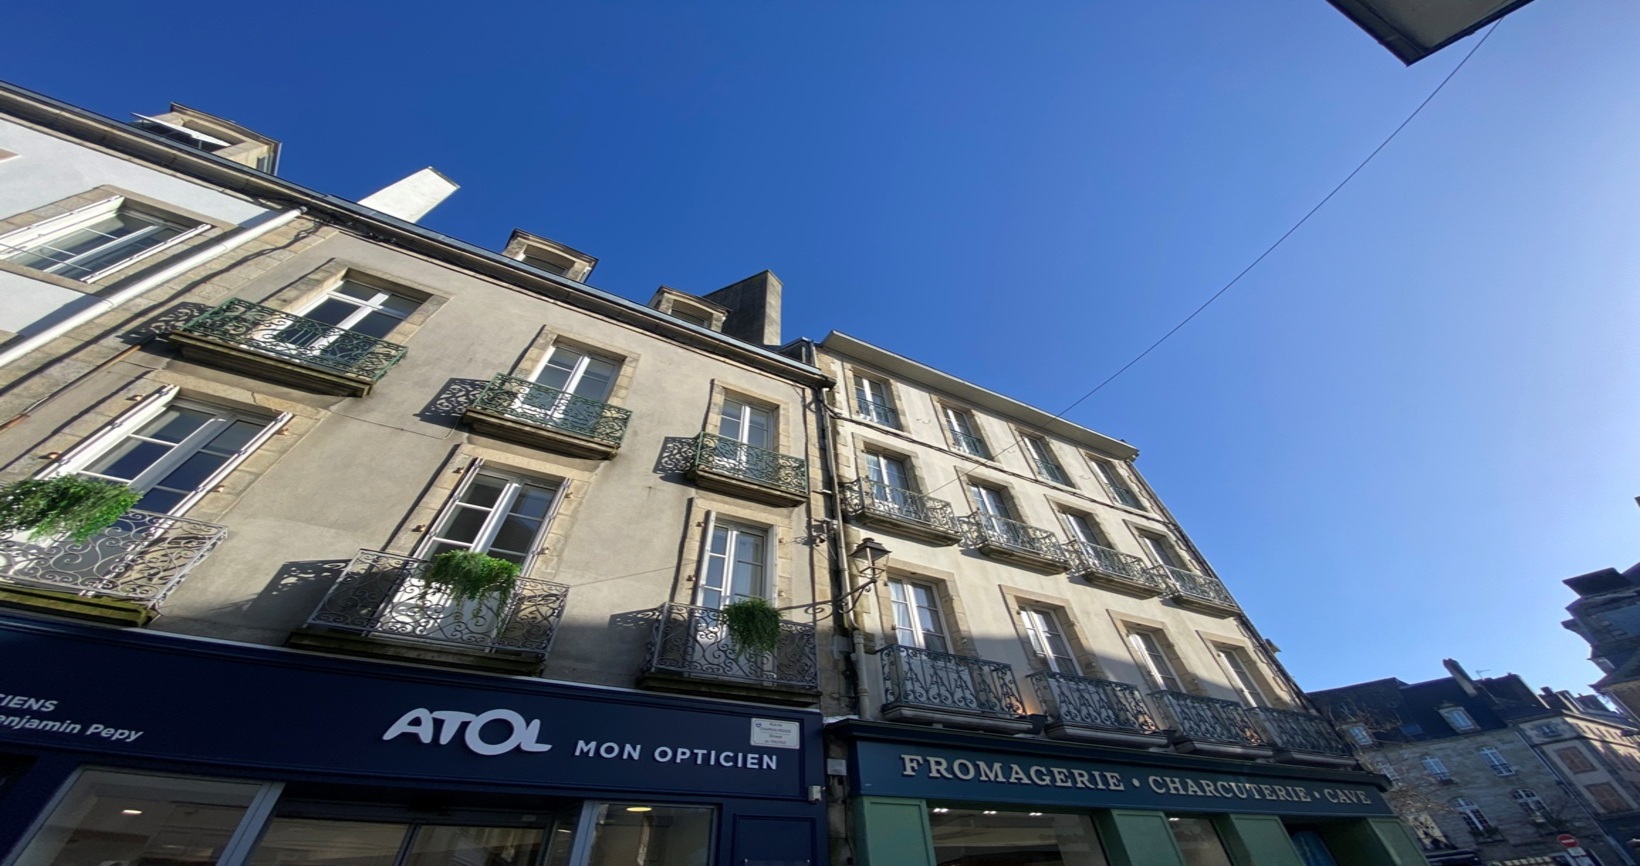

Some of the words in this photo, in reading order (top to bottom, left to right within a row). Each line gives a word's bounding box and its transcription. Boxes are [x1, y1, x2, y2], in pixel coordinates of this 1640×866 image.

[86, 723, 145, 743] Pepy
[382, 708, 552, 756] ATOL
[574, 740, 641, 760] MON
[654, 746, 777, 770] OPTICIEN
[901, 754, 1125, 790] FROMAGERIE
[1148, 776, 1311, 801] CHARCUTERIE
[1324, 788, 1372, 804] CAVE
